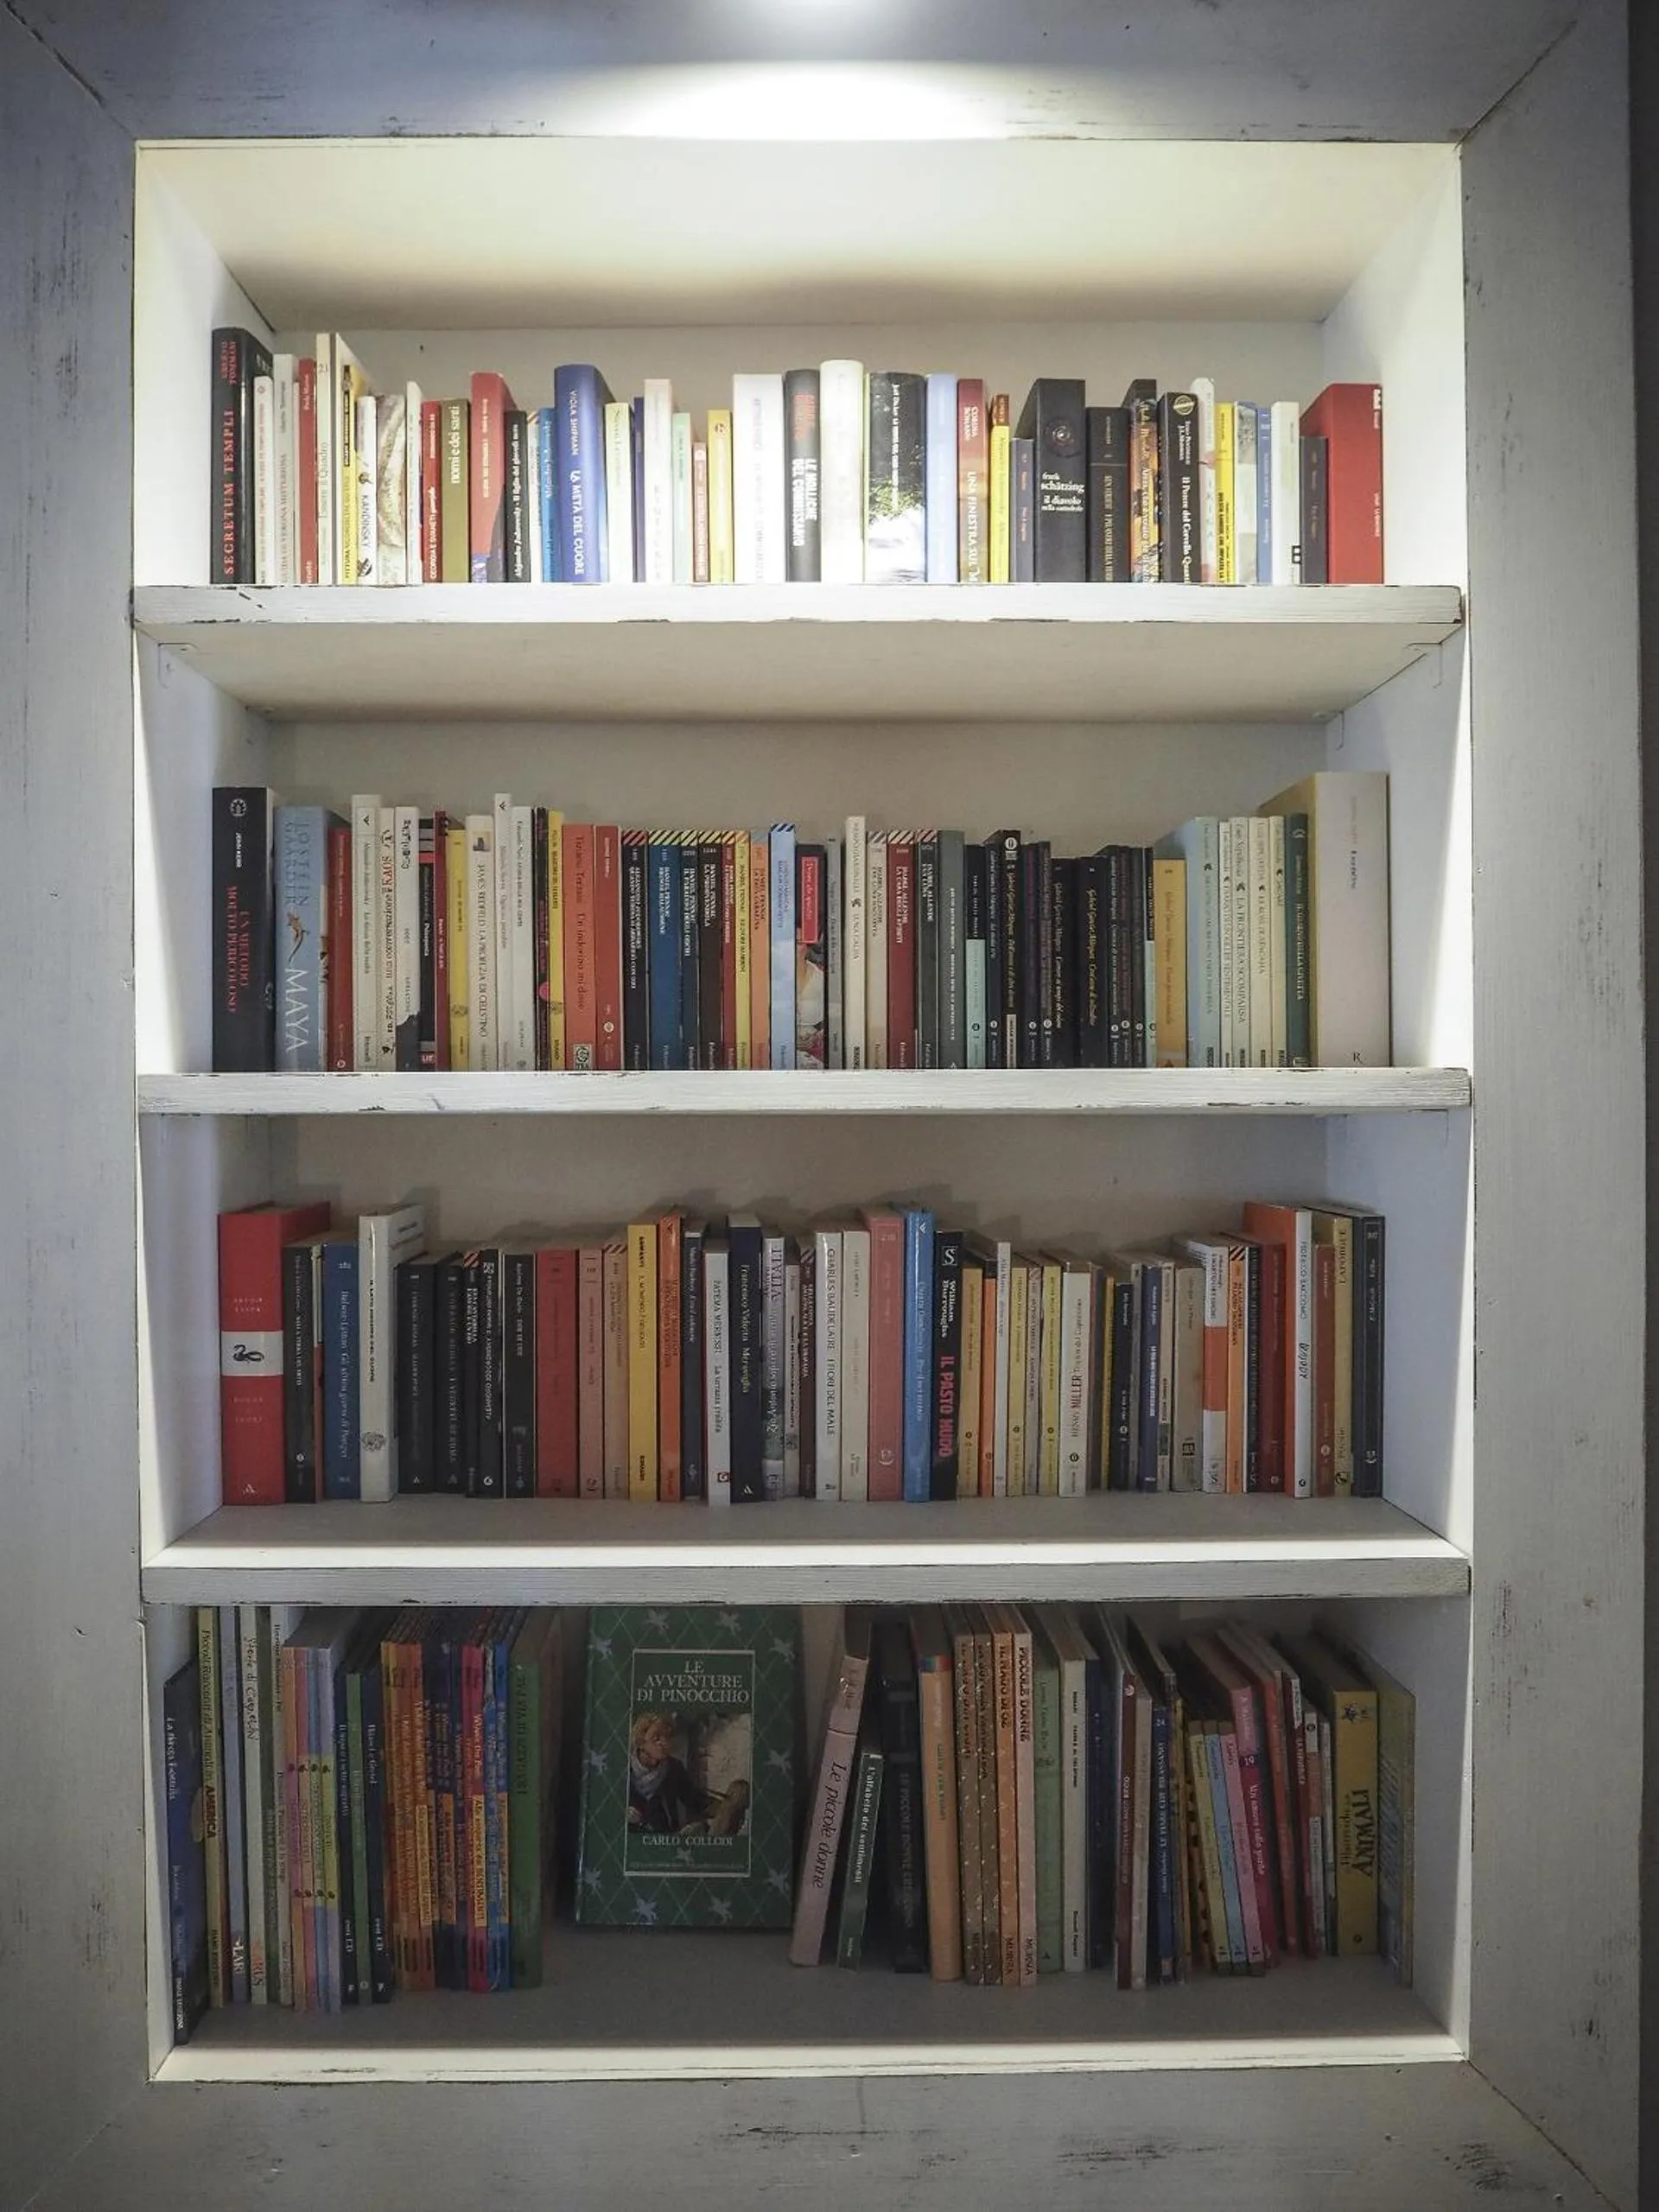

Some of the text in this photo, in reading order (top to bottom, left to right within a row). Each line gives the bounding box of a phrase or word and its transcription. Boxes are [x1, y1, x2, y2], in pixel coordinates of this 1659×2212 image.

[448, 406, 460, 431] santi
[223, 410, 234, 575] SECRETUM TEMPLI
[448, 456, 460, 484] nomi
[571, 515, 583, 536] DEL
[967, 496, 978, 546] FINESTRA
[573, 538, 585, 575] CUORE
[284, 822, 296, 906] GAARDER
[296, 822, 310, 906] JOSTEIN
[385, 893, 393, 959] conversazione
[285, 968, 309, 1054] MAYA
[740, 1264, 750, 1309] Francesco
[771, 1249, 783, 1300] VITALI
[826, 1249, 835, 1291] CHARLES
[826, 1294, 836, 1350] BAUDELAIRE
[940, 1280, 950, 1338] Burroughs
[740, 1348, 750, 1393] Meraviglia
[1071, 1375, 1082, 1408] MILLER
[826, 1409, 836, 1435] MALE
[938, 1355, 956, 1457] IL PASTO NUDO
[645, 1674, 742, 1688] AVVENTURE
[683, 1660, 704, 1674] LE
[637, 1688, 750, 1703] DI PINOCCHIO
[1019, 1646, 1031, 1743] PICCOLE DONNE
[205, 1784, 217, 1839] AMERICA
[812, 1761, 848, 1889] Le piccole donne
[1351, 1789, 1376, 1878] ANIMALI
[642, 1835, 734, 1846] CARLO COLLODI
